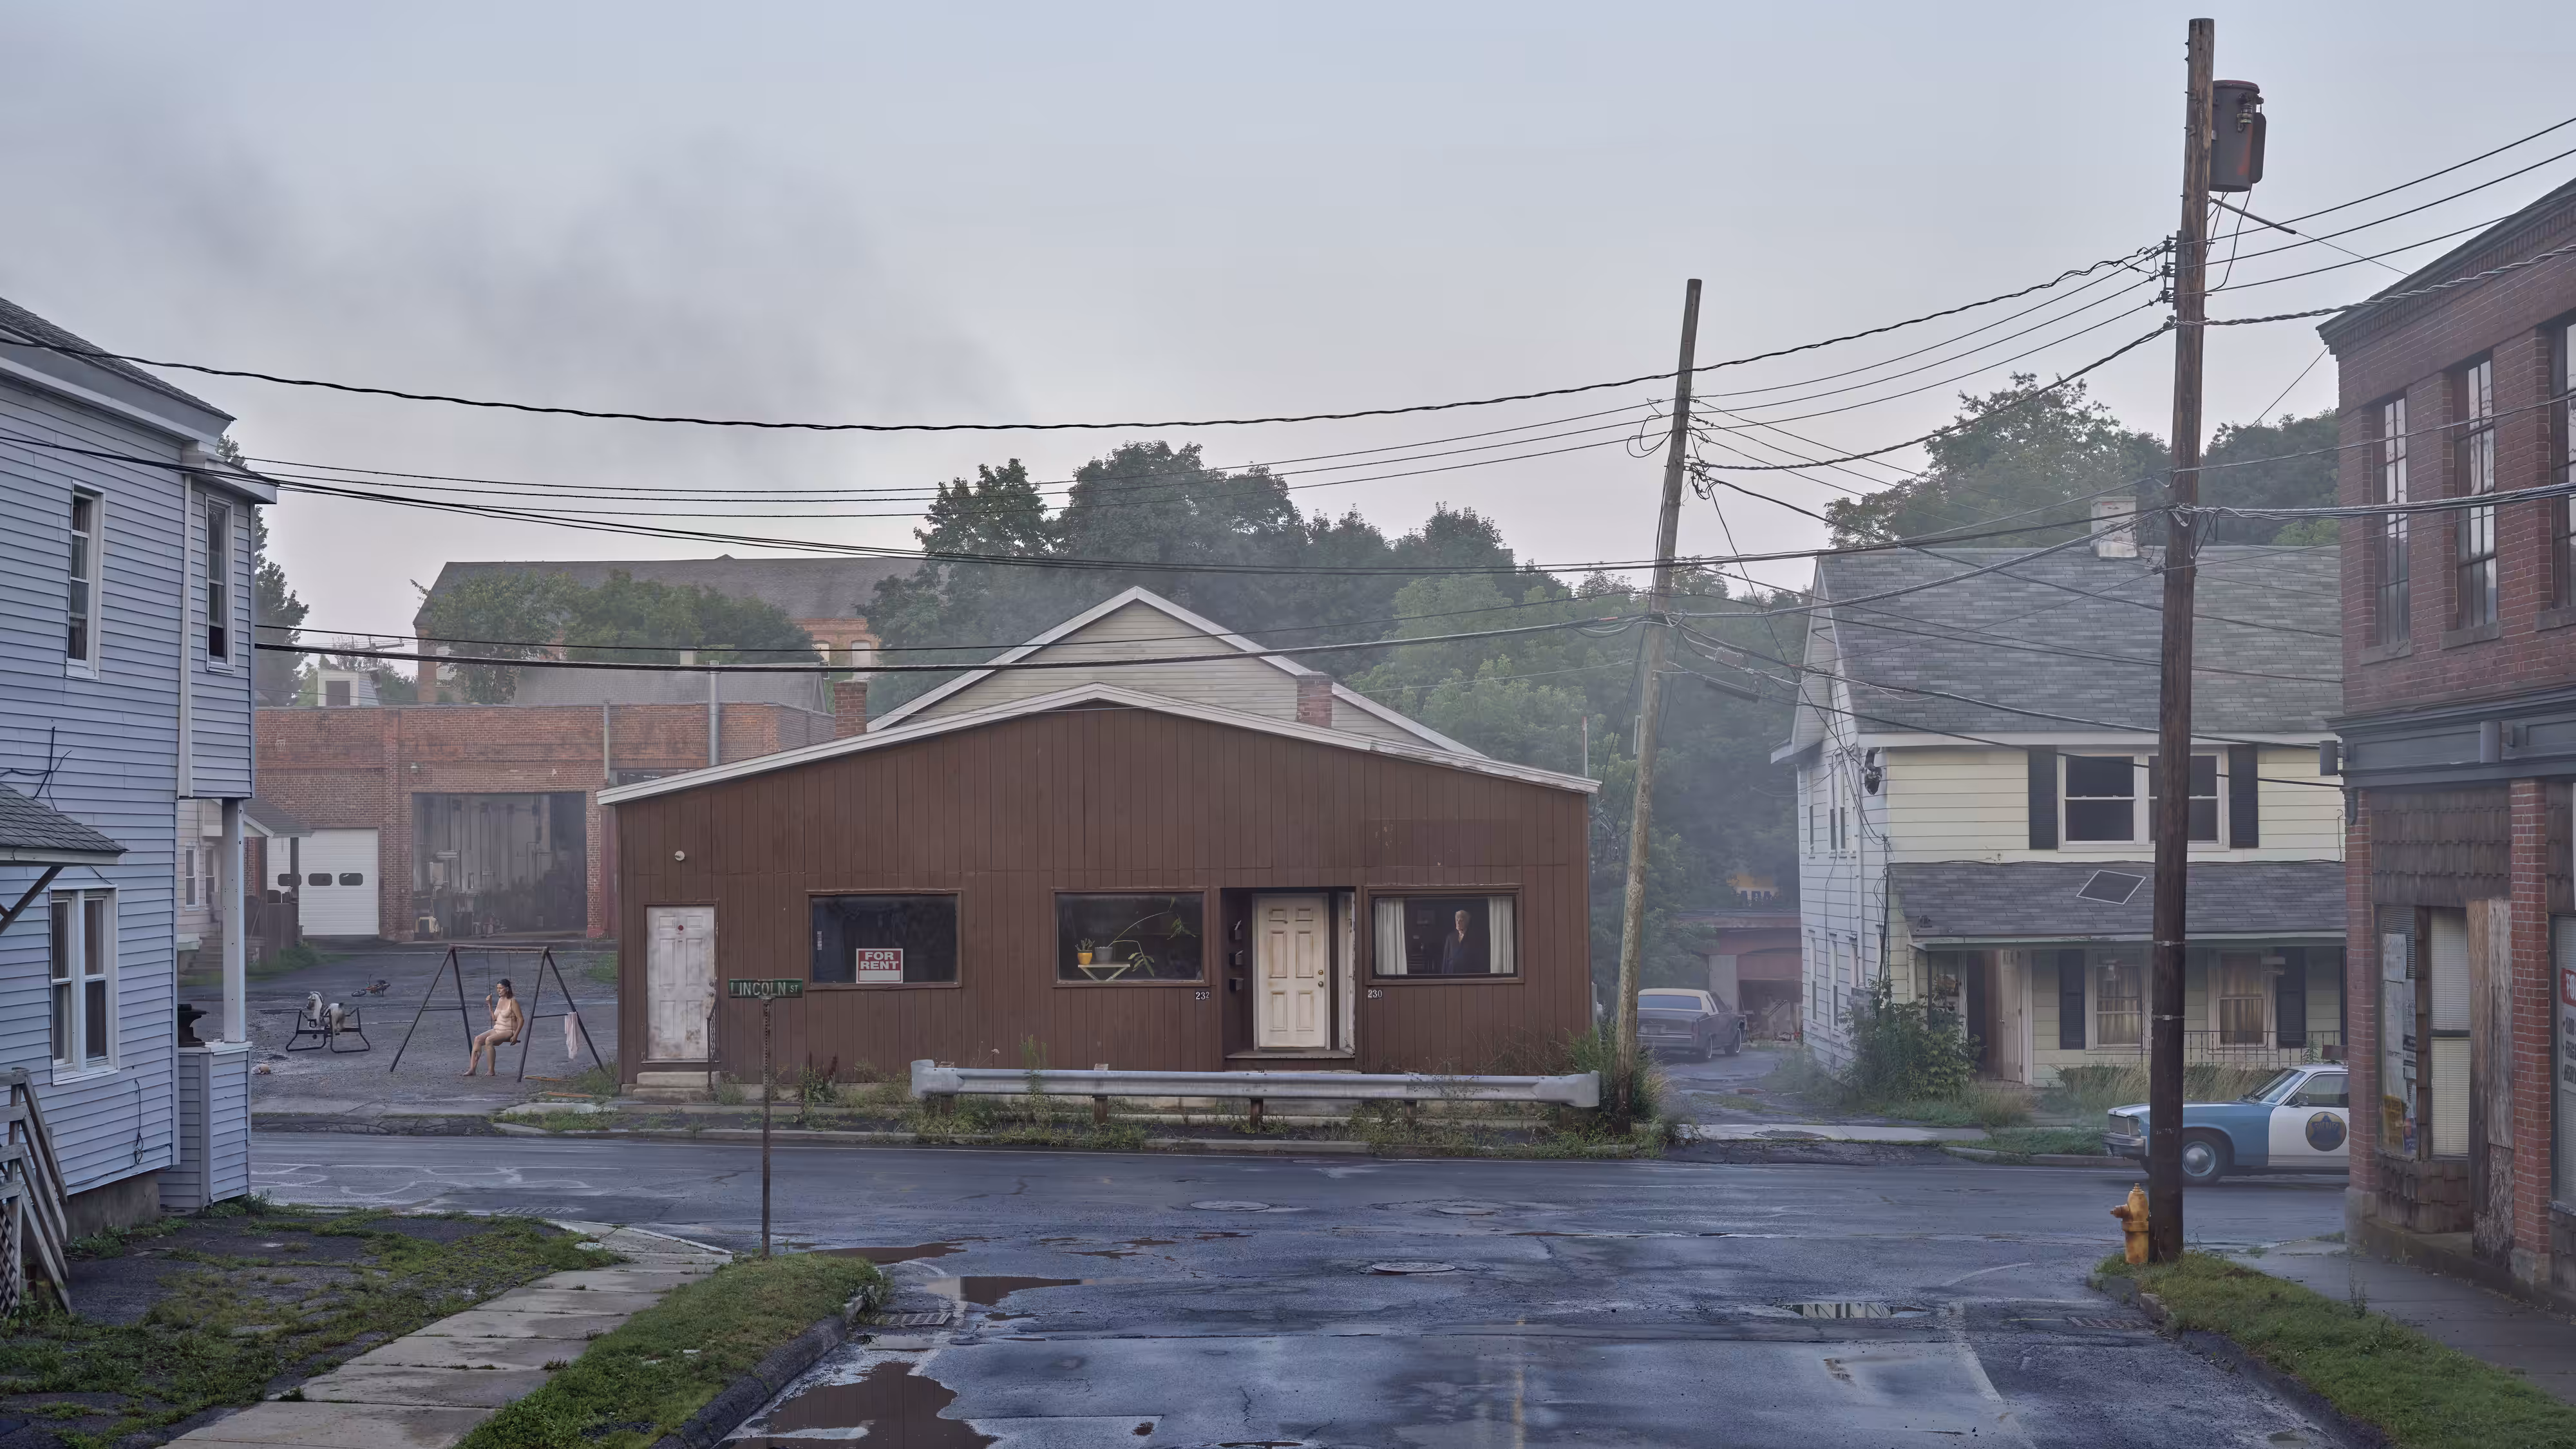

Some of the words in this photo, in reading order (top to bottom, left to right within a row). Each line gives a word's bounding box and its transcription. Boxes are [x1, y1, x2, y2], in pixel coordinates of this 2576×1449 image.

[865, 952, 894, 960] FOR
[860, 961, 899, 969] RENT
[731, 982, 786, 996] LINCOLN
[2566, 973, 2576, 1000] FO
[1195, 991, 1210, 1000] 232
[1367, 989, 1383, 998] 230
